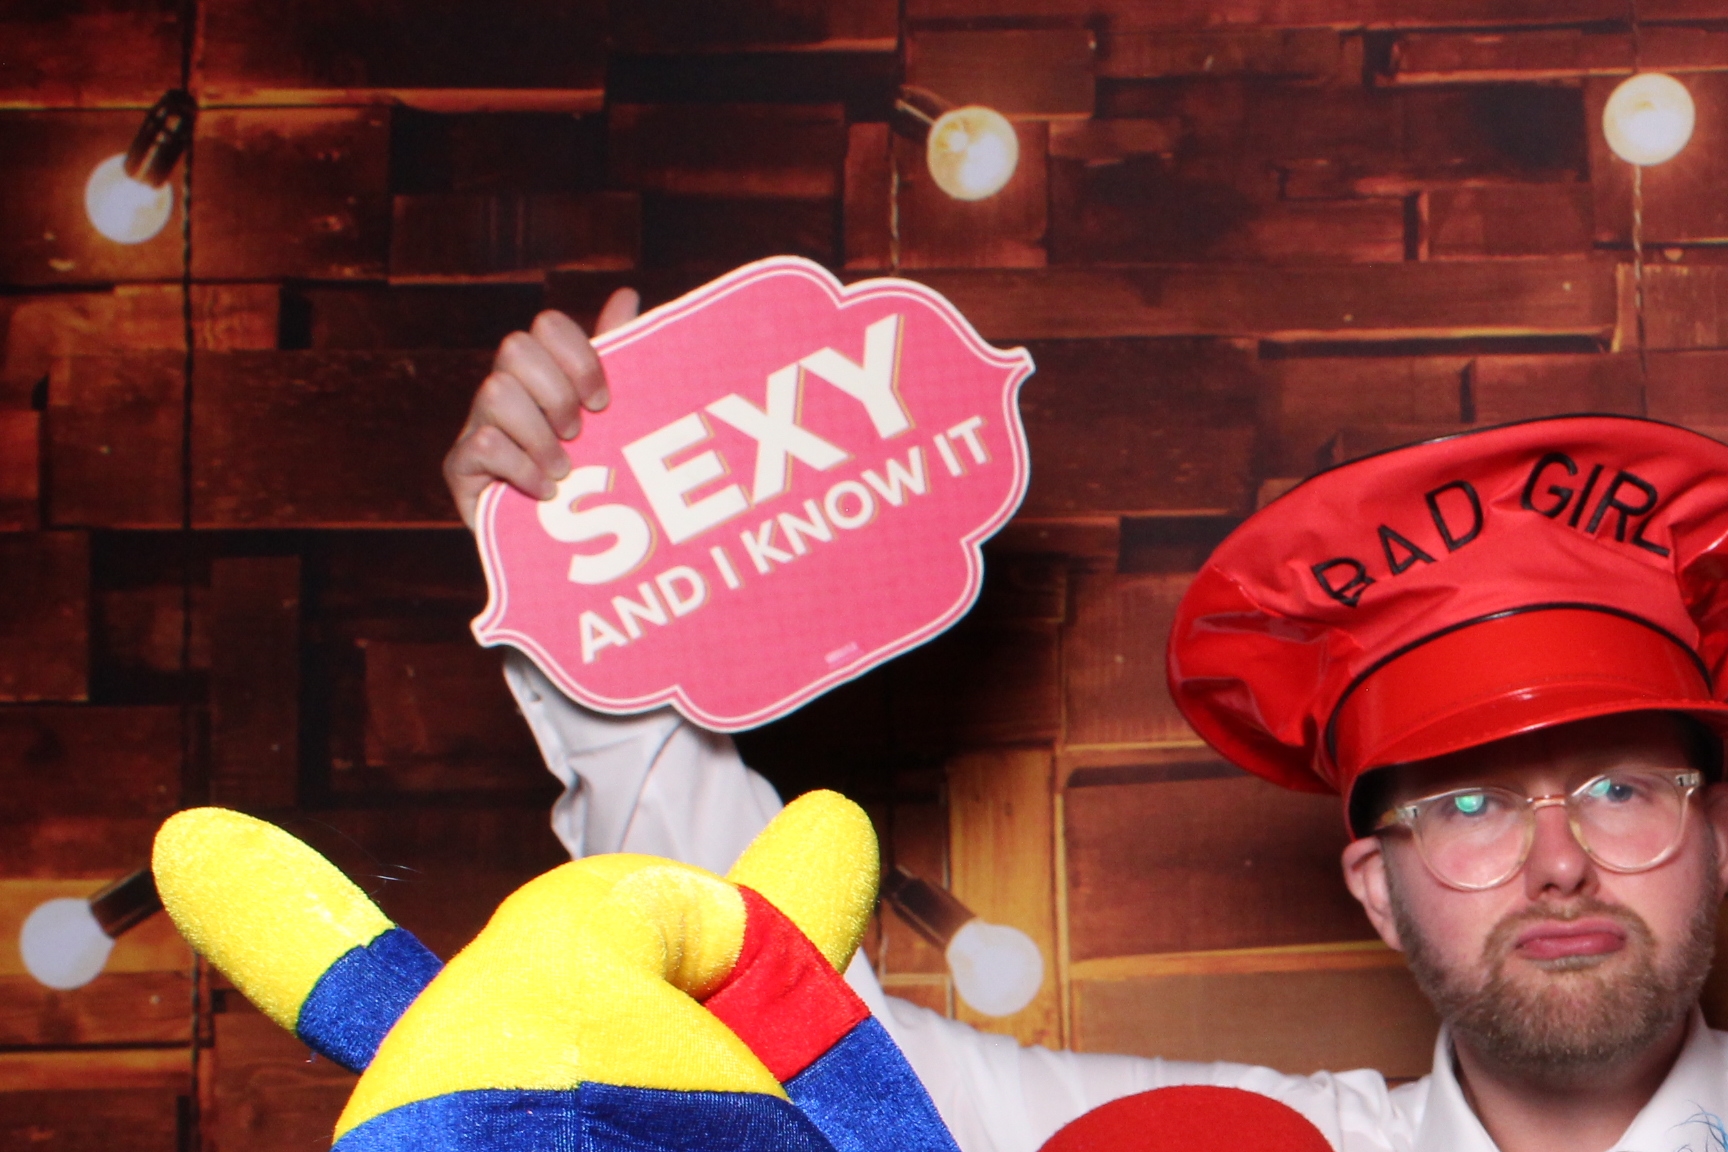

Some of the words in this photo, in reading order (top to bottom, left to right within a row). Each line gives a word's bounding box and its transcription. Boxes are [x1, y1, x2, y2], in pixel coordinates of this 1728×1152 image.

[535, 312, 914, 585] SEXY
[576, 566, 709, 665] AND
[709, 546, 742, 591] I
[740, 445, 927, 575] KNOW
[933, 415, 992, 477] IT
[1309, 479, 1484, 609] BAD
[1520, 451, 1671, 558] GIRL
